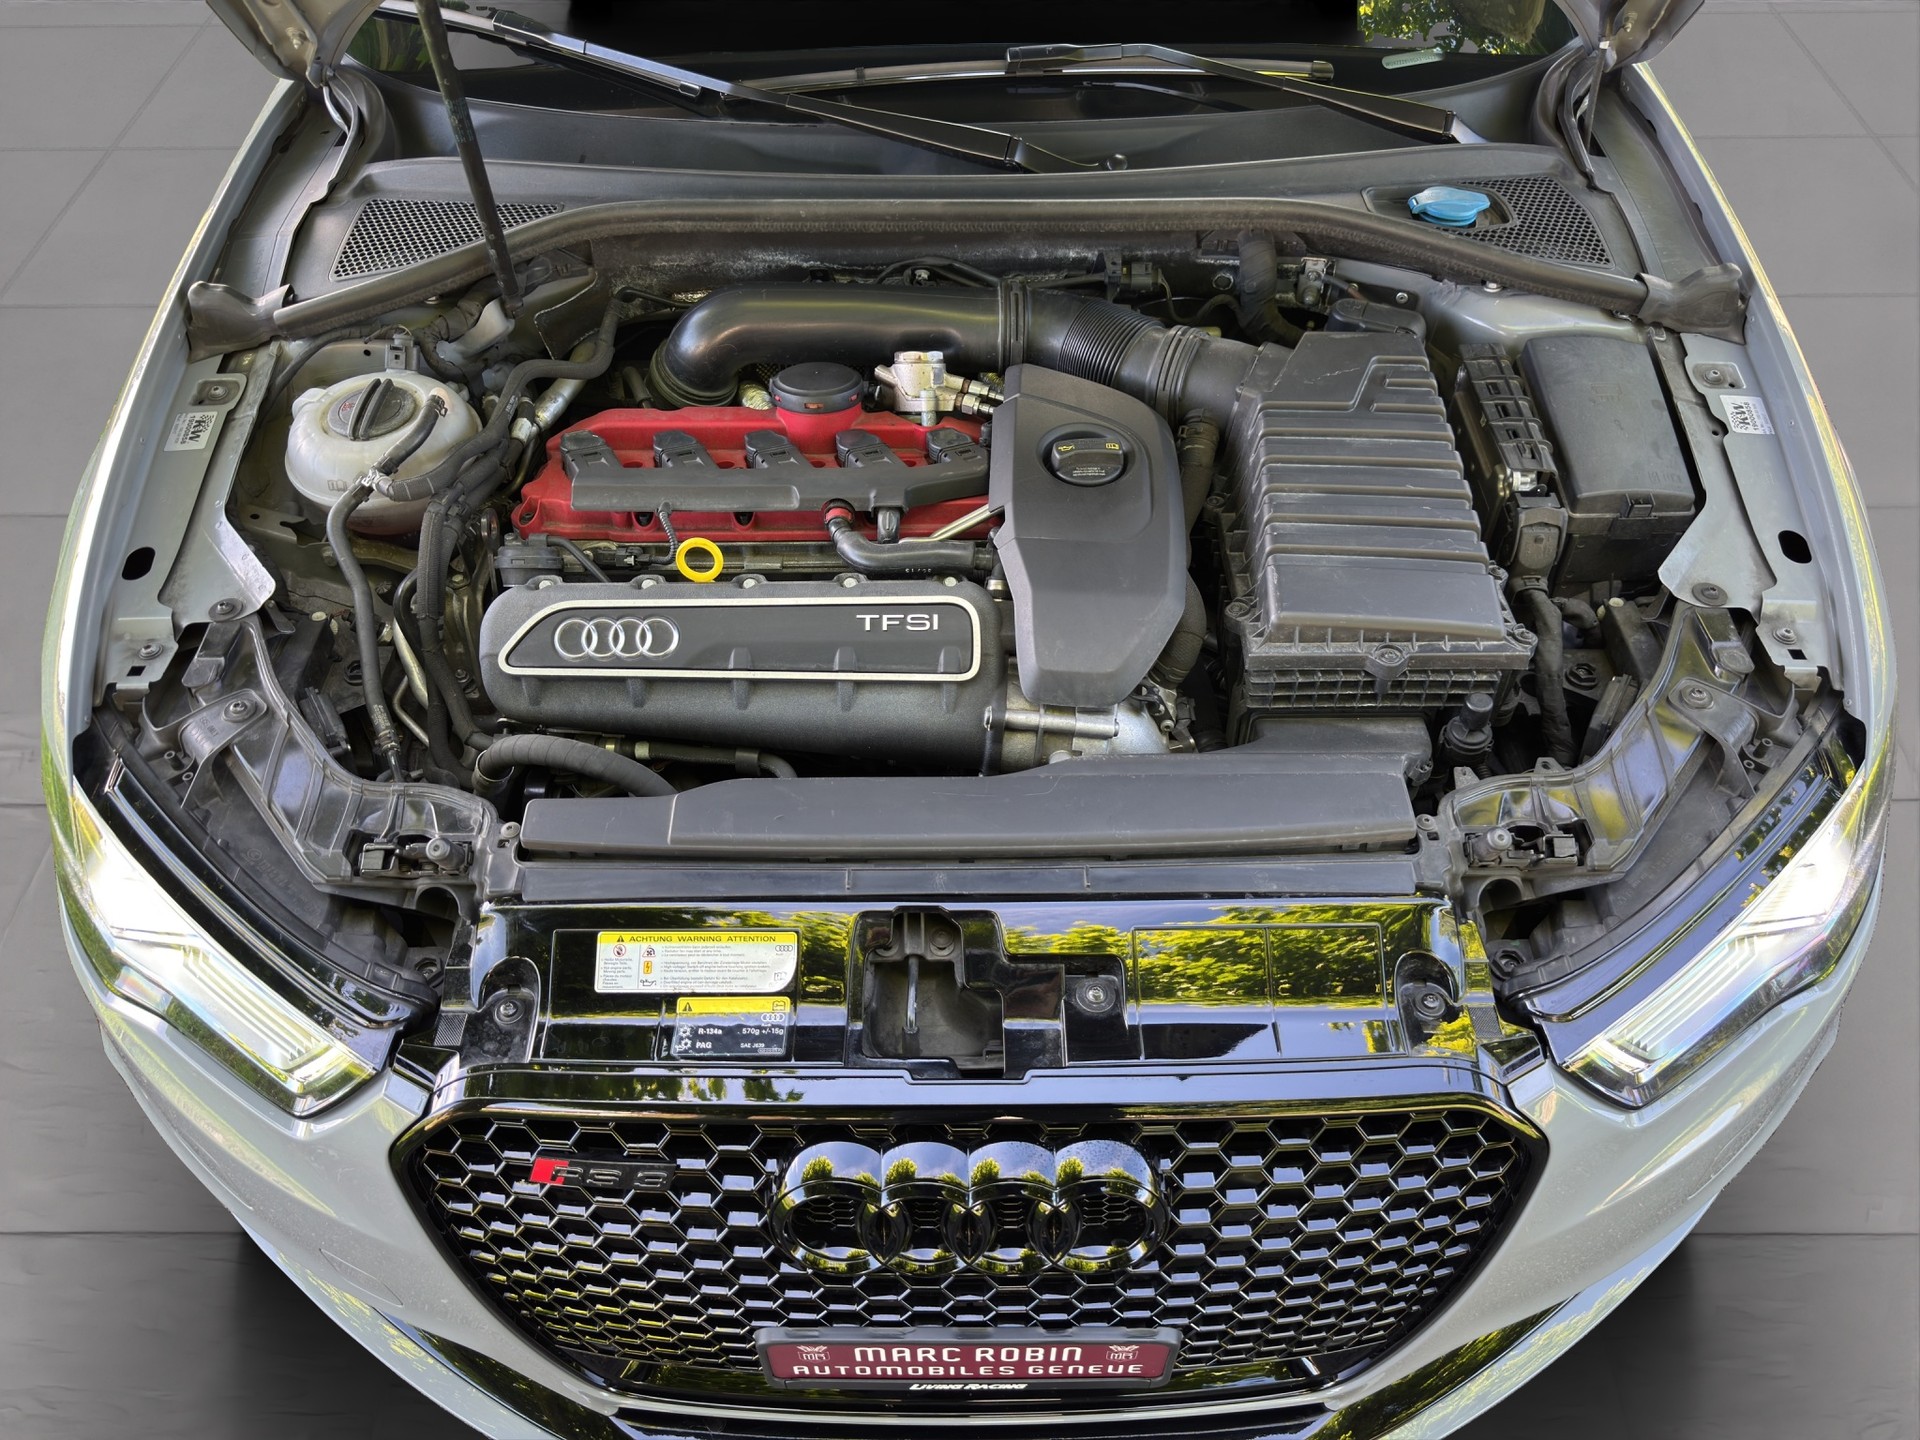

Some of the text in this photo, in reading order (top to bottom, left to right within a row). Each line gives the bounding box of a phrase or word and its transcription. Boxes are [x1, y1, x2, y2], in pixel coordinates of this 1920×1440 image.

[188, 419, 206, 442] KW
[856, 613, 939, 631] TFSI
[629, 935, 777, 943] ACHTUNG WARNING ATTENTION
[697, 1027, 723, 1035] R-134a
[741, 1027, 760, 1036] 570g
[695, 1041, 713, 1049] PAG
[854, 1346, 1083, 1363] MARC ROBIN
[792, 1365, 1016, 1376] AUTOMOBILES
